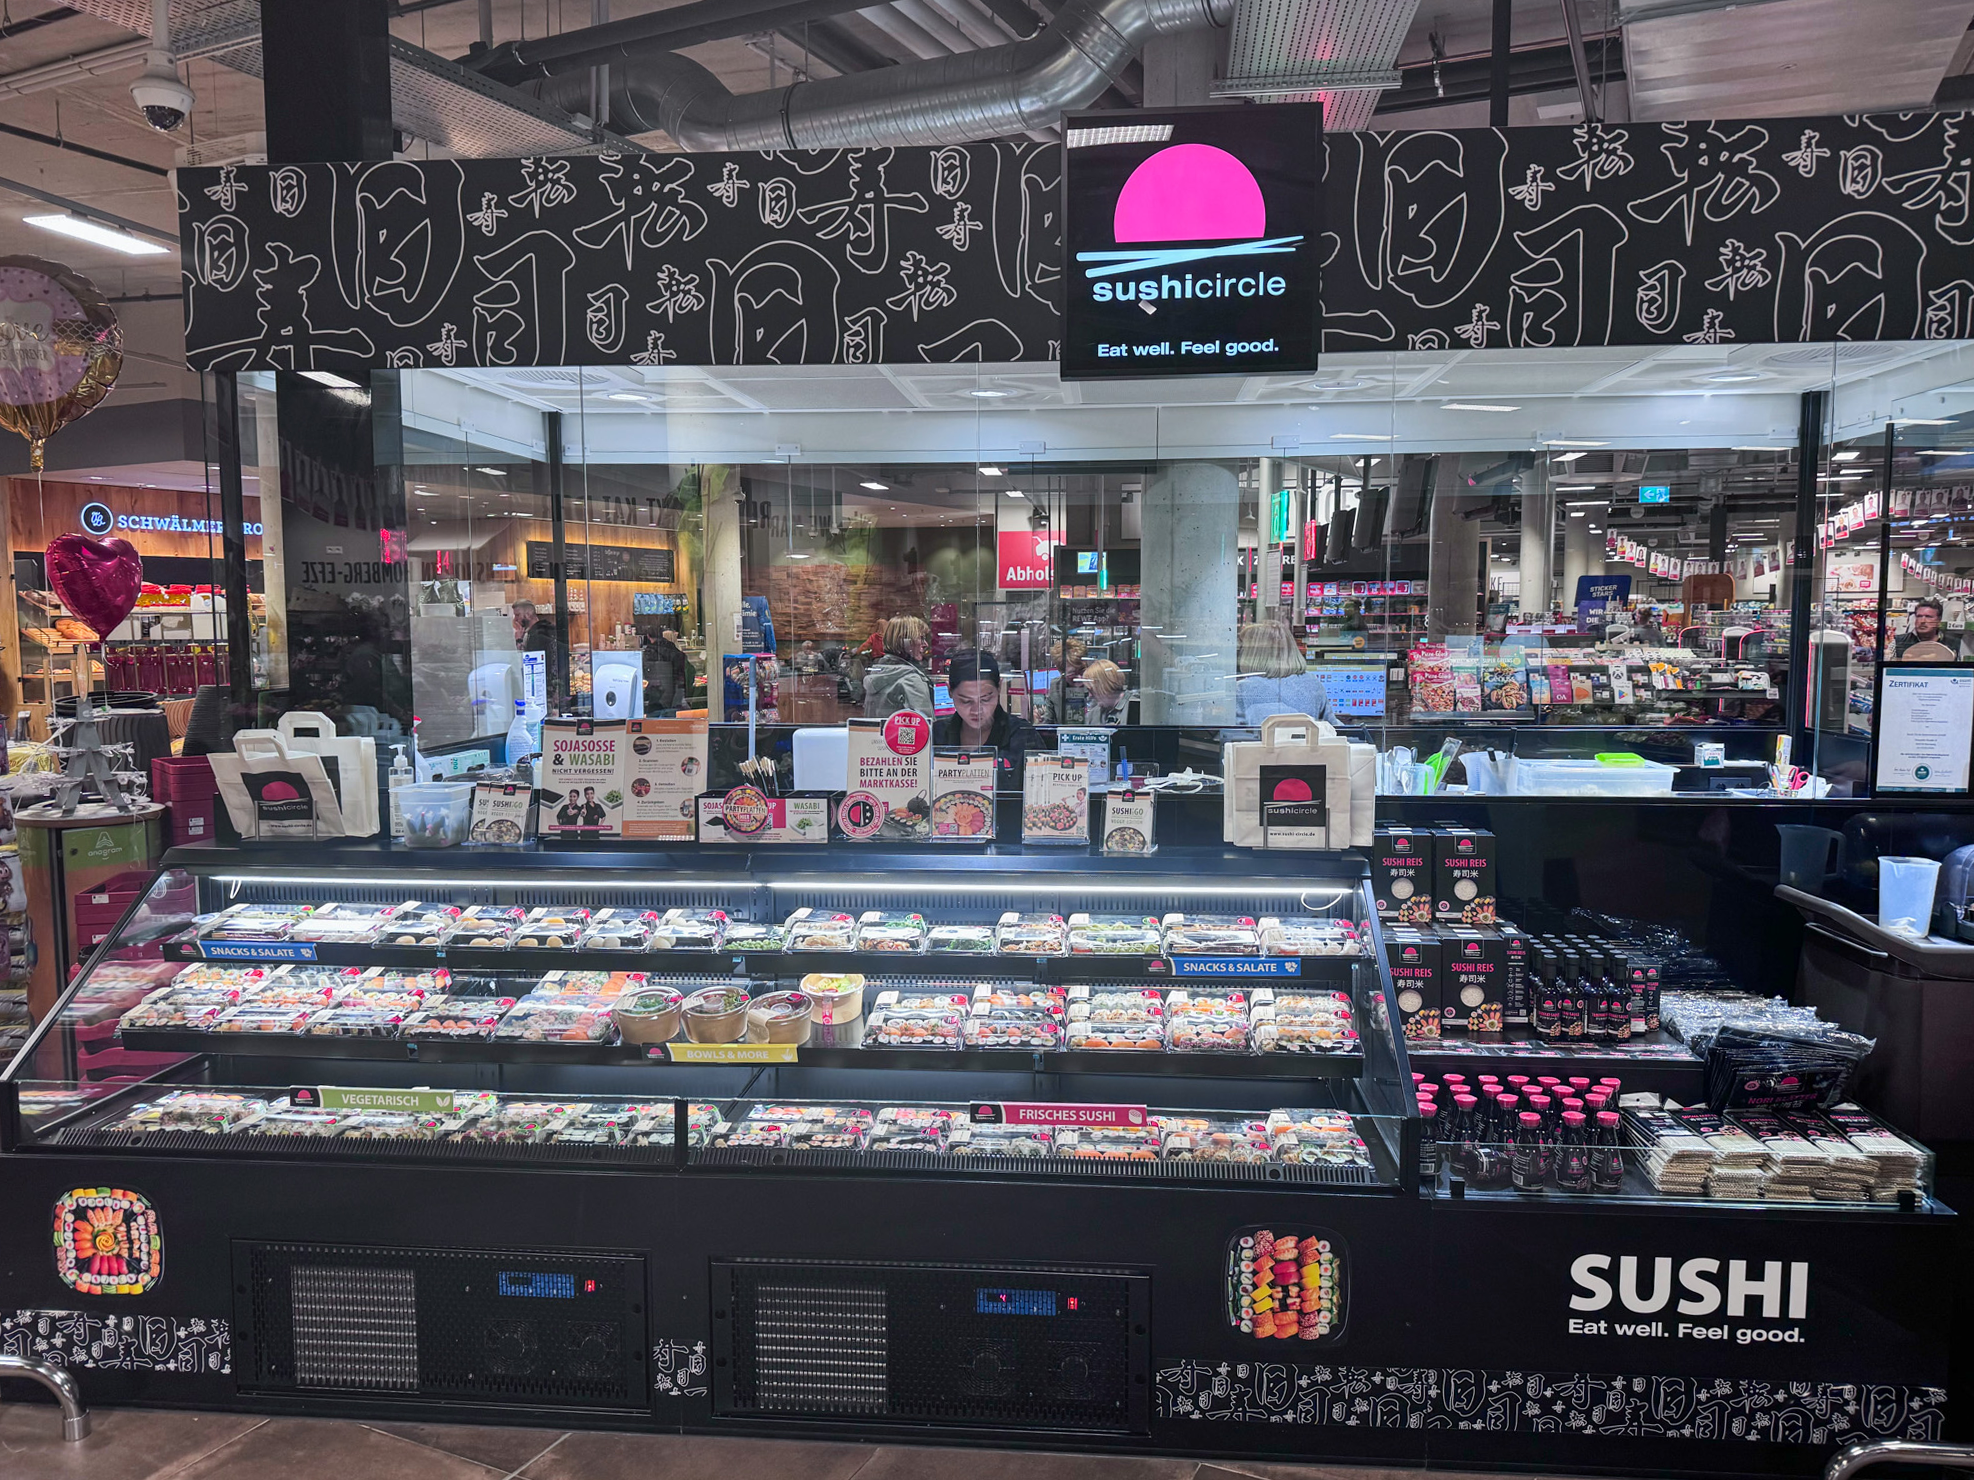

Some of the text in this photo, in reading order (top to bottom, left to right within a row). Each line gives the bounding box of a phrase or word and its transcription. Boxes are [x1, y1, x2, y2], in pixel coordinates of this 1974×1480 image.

[1092, 271, 1286, 301] sushicircle
[1098, 339, 1279, 357] Eat well. Feel good.
[1589, 585, 1618, 593] STICKER
[1072, 607, 1094, 615] Nutzen
[1093, 615, 1109, 624] App?
[1889, 680, 1928, 688] ZERTIFIKAT
[894, 716, 920, 725] PICK UP
[553, 740, 615, 752] SOJASOSSE
[552, 753, 615, 766] & WASABI
[860, 757, 918, 766] BEZAHLEN SIE
[860, 768, 918, 777] BITTE AN DER
[938, 769, 990, 778] PARTYPLATTEN
[1052, 773, 1083, 782] PICK UP
[859, 779, 918, 788] MARKTKASSE!
[703, 802, 723, 810] SOJAS
[725, 805, 766, 814] PARTYPLATTEN
[1268, 807, 1318, 815] sushicircle
[88, 847, 122, 857] anagram
[1382, 858, 1423, 866] SUSHI REIS
[1445, 859, 1487, 868] SUSHI REIS
[1390, 868, 1415, 877] 寿司米
[1453, 869, 1479, 878] 寿司米
[210, 947, 295, 957] SNACKS & SALATE
[1183, 962, 1277, 972] SNACKS & SALATE
[1451, 963, 1494, 972] SUSHI REIS
[1390, 968, 1433, 977] SUSHI REIS
[1397, 979, 1424, 988] 寿司米
[1459, 974, 1486, 984] 寿司米
[687, 1050, 769, 1059] BOWLS & MORE
[341, 1094, 419, 1106] VEGETARISCH
[1019, 1109, 1116, 1121] FRISCHES SUSHI
[1568, 1253, 1809, 1319] SUSHI
[1568, 1318, 1805, 1345] Eat well. Feel good.
